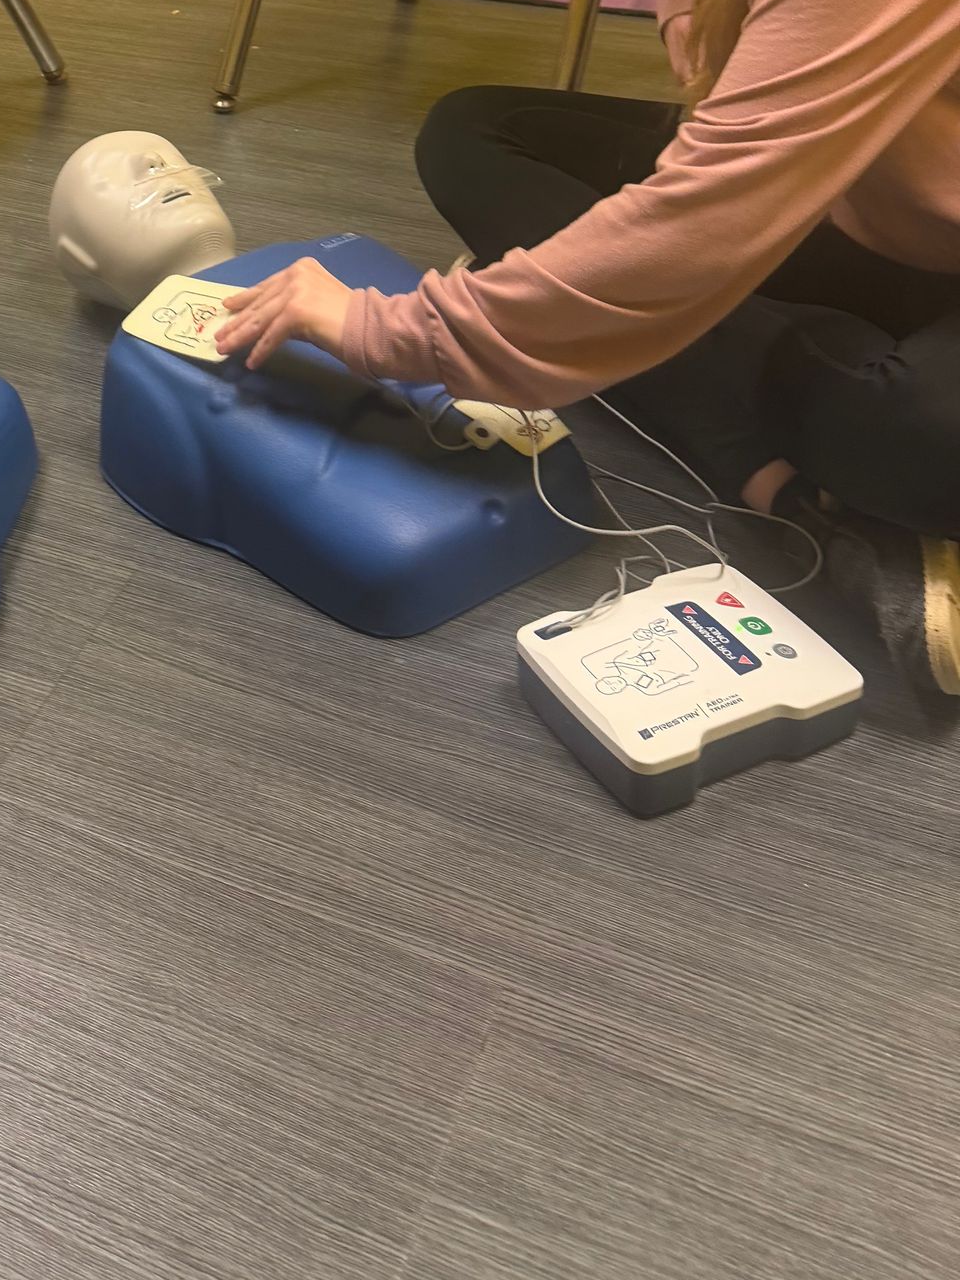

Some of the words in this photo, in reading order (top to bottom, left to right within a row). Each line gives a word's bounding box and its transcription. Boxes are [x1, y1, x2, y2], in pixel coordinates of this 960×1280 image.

[683, 615, 720, 647] TRAINING
[706, 626, 730, 644] ONLY
[709, 697, 744, 713] TRAINER
